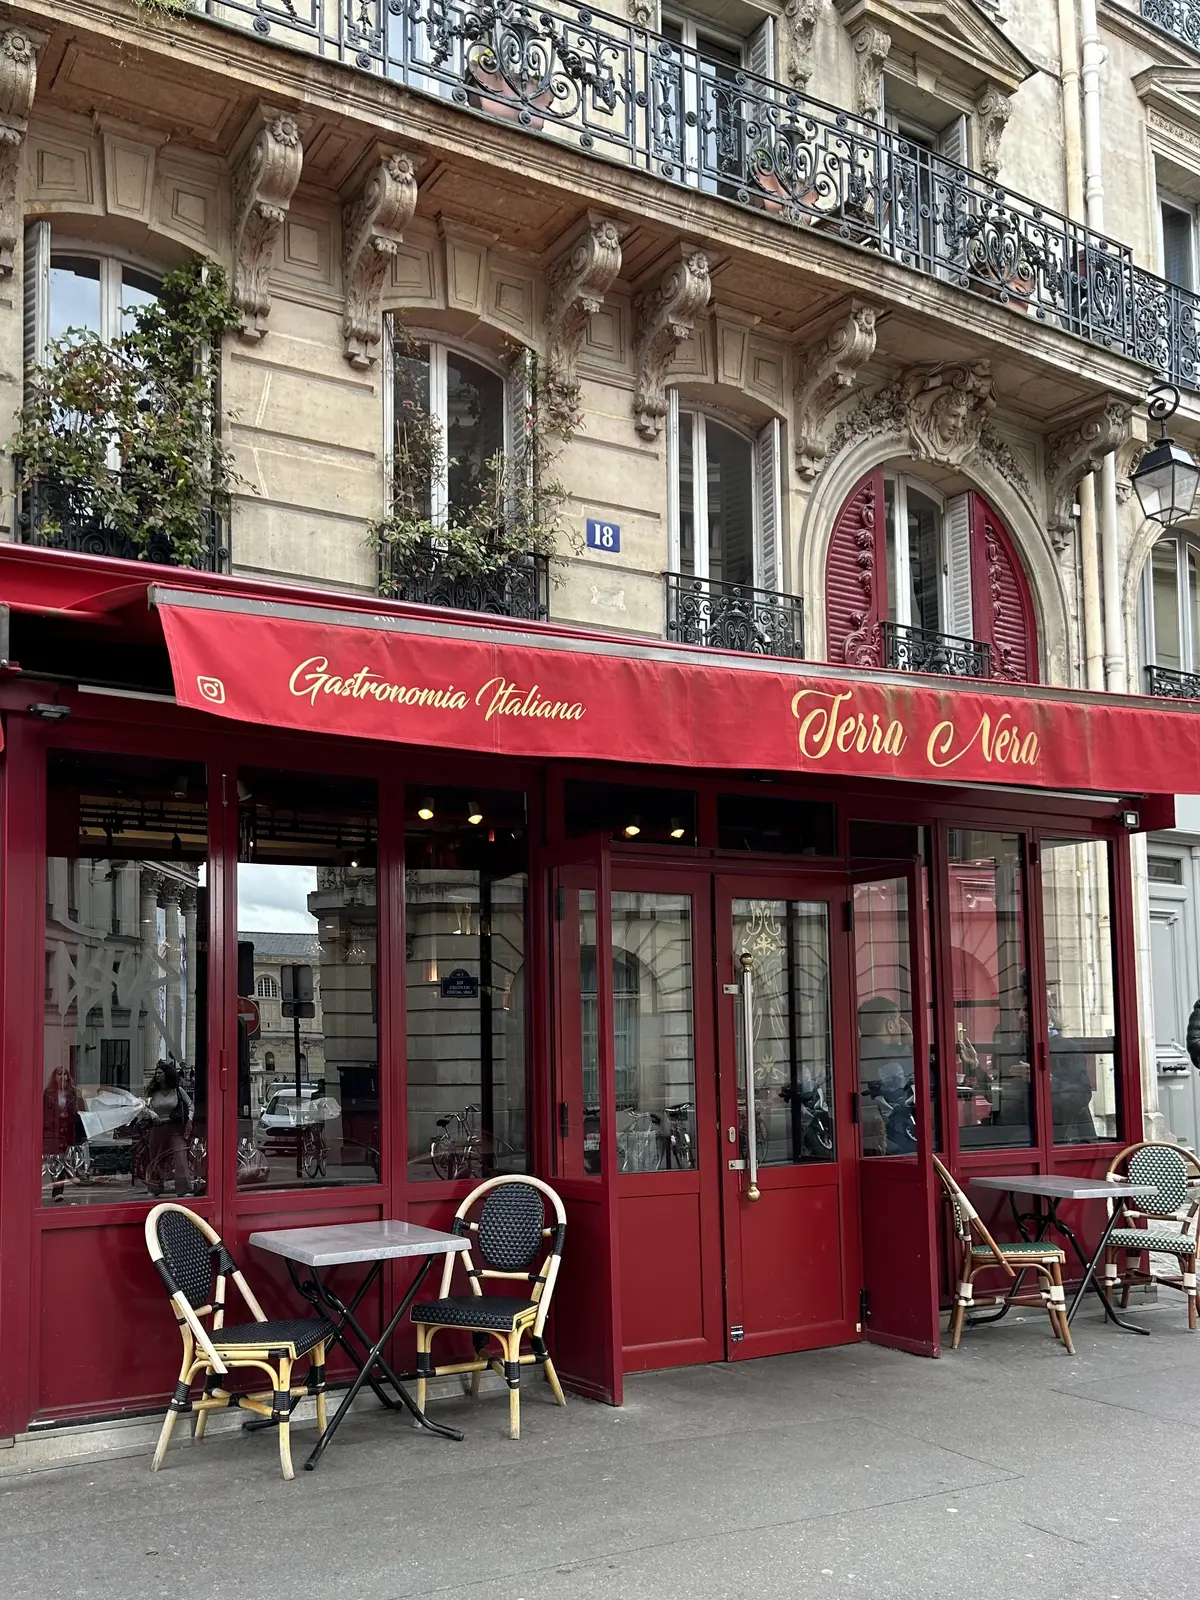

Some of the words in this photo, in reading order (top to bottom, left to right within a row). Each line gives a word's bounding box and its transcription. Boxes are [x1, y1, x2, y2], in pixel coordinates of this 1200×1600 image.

[594, 523, 614, 547] 18
[289, 656, 470, 709] Gastronomia
[475, 677, 587, 722] Italiana
[791, 689, 908, 759] Terra
[927, 711, 1041, 768] Nera
